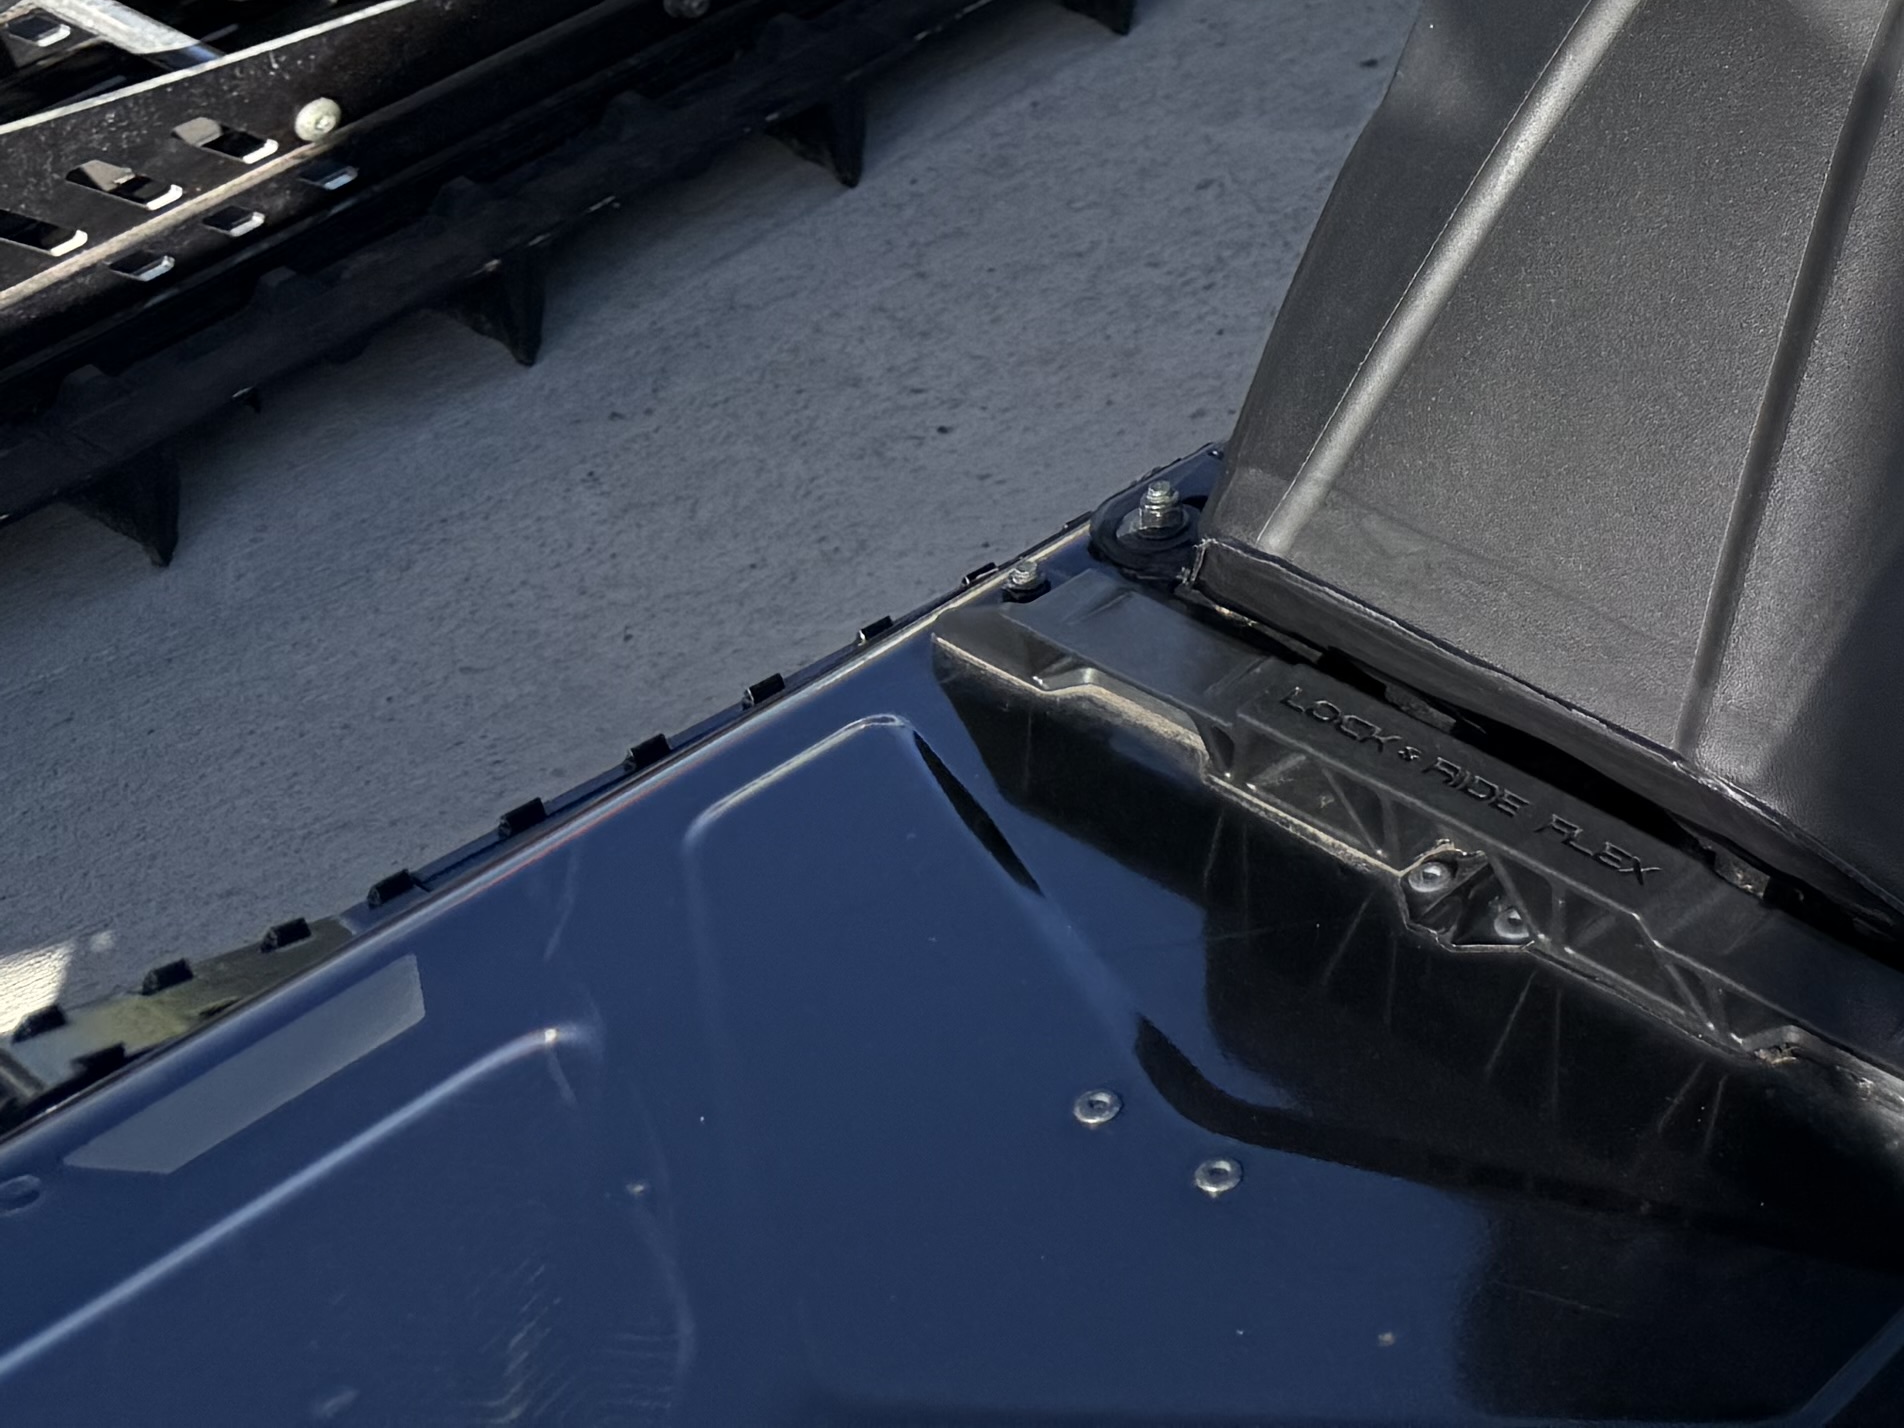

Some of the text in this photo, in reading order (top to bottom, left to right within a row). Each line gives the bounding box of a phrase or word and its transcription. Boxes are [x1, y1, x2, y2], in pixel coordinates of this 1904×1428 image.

[1280, 687, 1402, 751] LOCK
[1423, 756, 1532, 818] RIDE
[1534, 812, 1662, 885] FLEX
